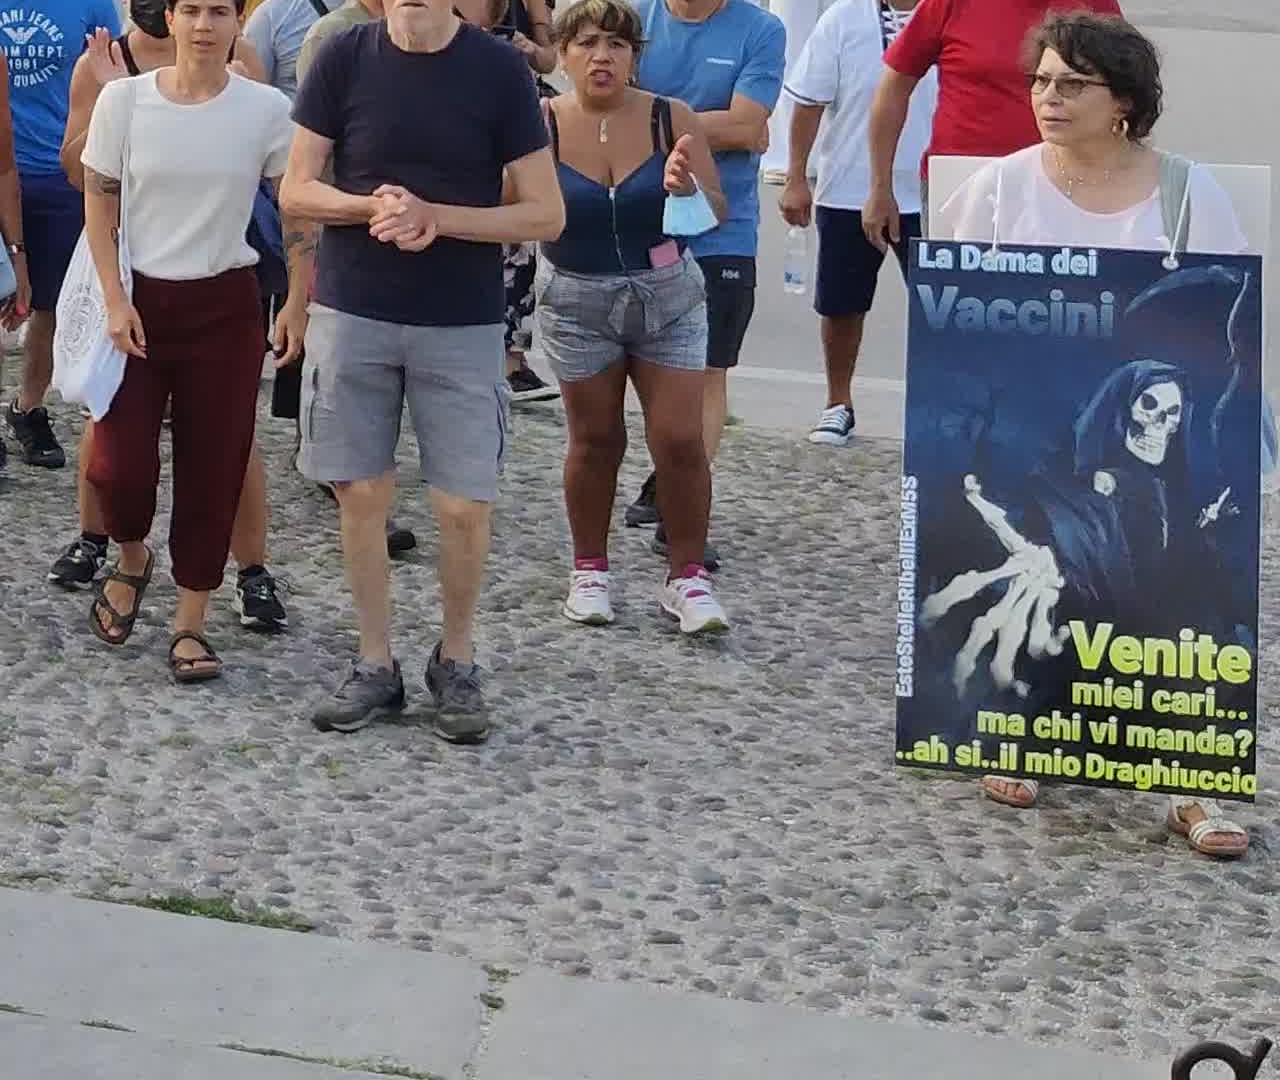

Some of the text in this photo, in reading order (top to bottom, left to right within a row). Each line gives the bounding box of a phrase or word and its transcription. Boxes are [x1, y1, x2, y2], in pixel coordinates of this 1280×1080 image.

[28, 10, 64, 43] JEANS
[8, 58, 38, 69] 1981
[13, 64, 59, 88] QUALITY
[918, 241, 1098, 277] La Dama dei
[916, 284, 1114, 337] Vaccini
[1068, 620, 1253, 684] Venite
[1071, 676, 1249, 720] miei cari...
[976, 709, 1254, 759] ma chi vi manda?
[1024, 747, 1081, 777] mio
[1085, 752, 1257, 795] Draghiuccio
